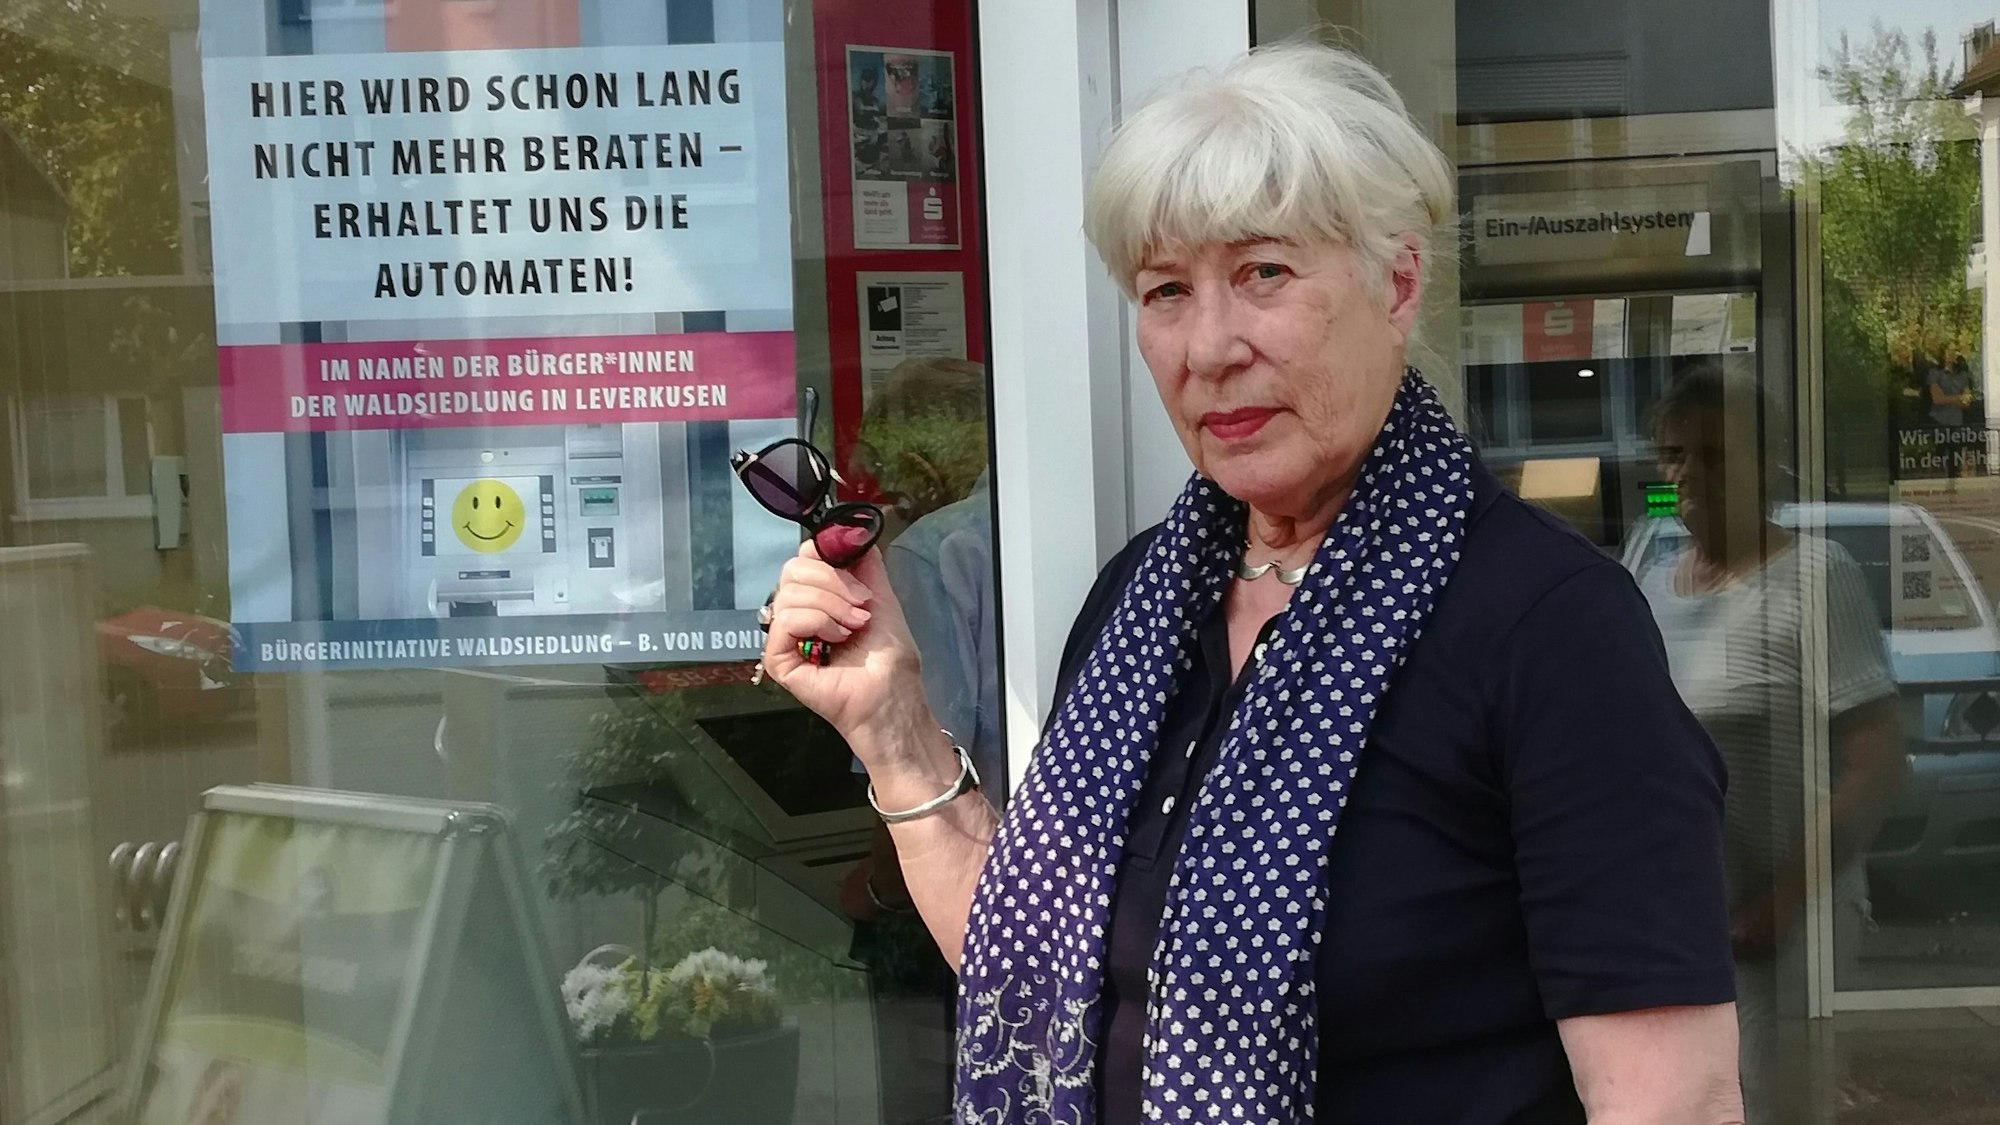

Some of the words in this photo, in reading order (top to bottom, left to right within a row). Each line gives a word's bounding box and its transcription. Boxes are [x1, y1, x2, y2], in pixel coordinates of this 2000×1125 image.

[251, 80, 347, 117] HIER
[360, 78, 470, 114] WIRD
[486, 73, 618, 111] SCHON
[636, 69, 740, 107] LANG
[254, 141, 374, 178] NICHT
[392, 138, 506, 175] MEHR
[523, 132, 702, 172] BERATEN
[314, 199, 512, 238] ERHALTET
[529, 196, 608, 233] UNS
[625, 194, 688, 230] DIE
[374, 257, 634, 298] AUTOMATEN!
[321, 359, 350, 381] IM
[358, 356, 444, 380] NAMEN
[453, 355, 500, 378] DER
[291, 396, 337, 418] DER
[344, 389, 534, 416] WALDSIEDLUNG
[542, 389, 567, 411] IN
[576, 384, 727, 410] LEVERKUSEN
[1899, 429, 1931, 446] Wir
[1934, 427, 1989, 445] bleibe
[1900, 453, 1916, 470] in
[1920, 452, 1949, 469] der
[1953, 447, 1989, 467] Näh
[261, 639, 451, 662] BÜRGERINITIATIVE
[456, 634, 612, 656] WALDSIEDLUNG
[638, 634, 658, 651] B.
[663, 631, 704, 651] VON
[710, 630, 762, 650] BONI
